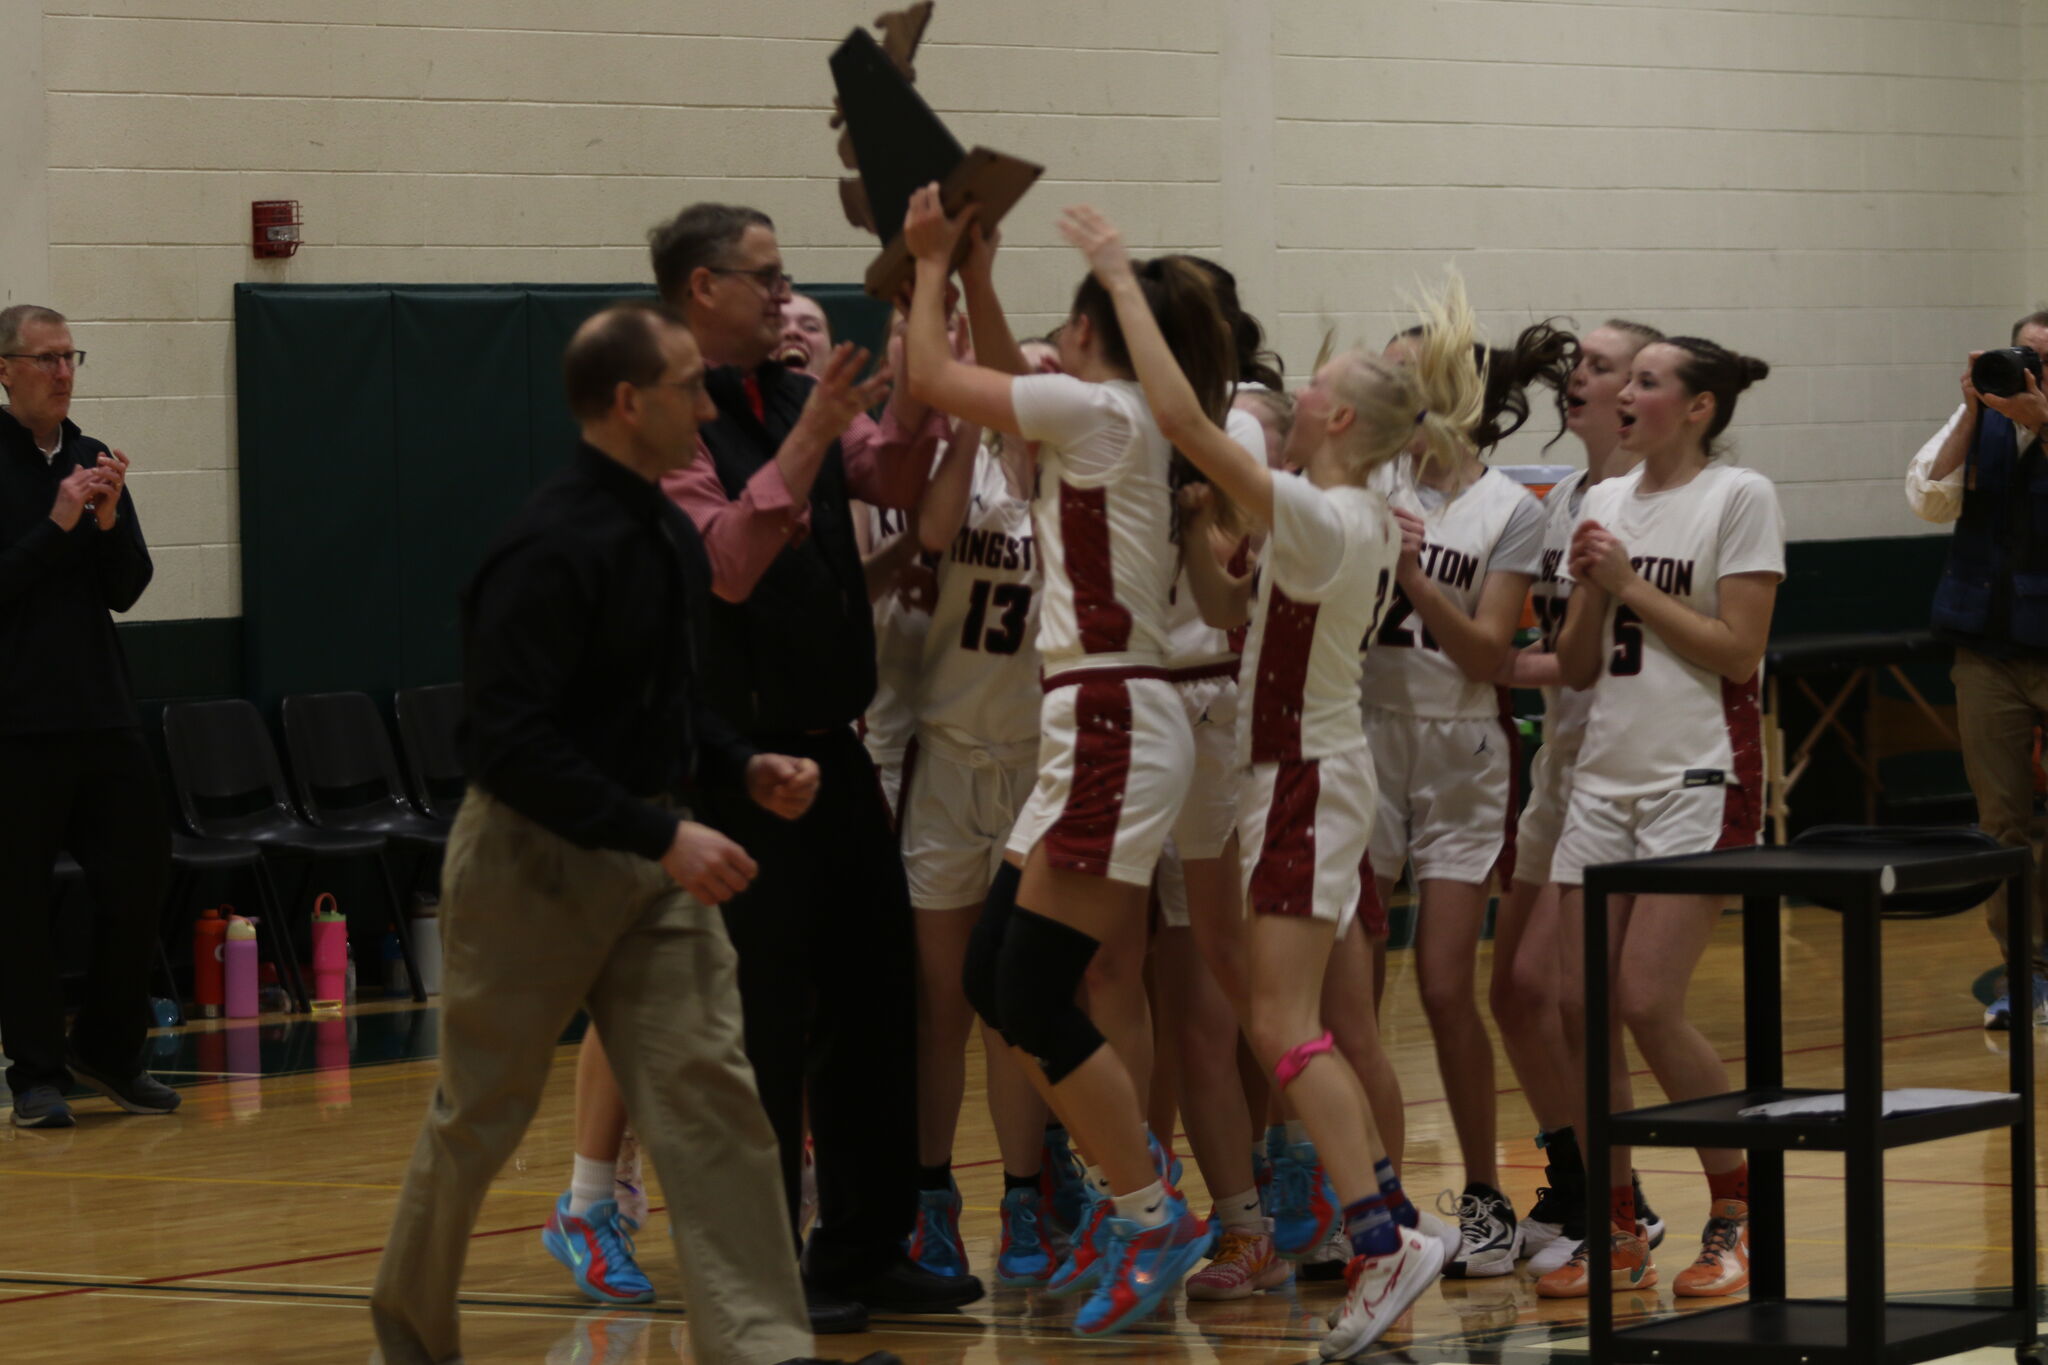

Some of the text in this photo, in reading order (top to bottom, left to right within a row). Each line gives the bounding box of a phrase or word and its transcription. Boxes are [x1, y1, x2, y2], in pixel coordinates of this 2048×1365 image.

[952, 527, 1033, 571] INGST
[961, 579, 1033, 655] 13
[1611, 604, 1643, 676] 5
